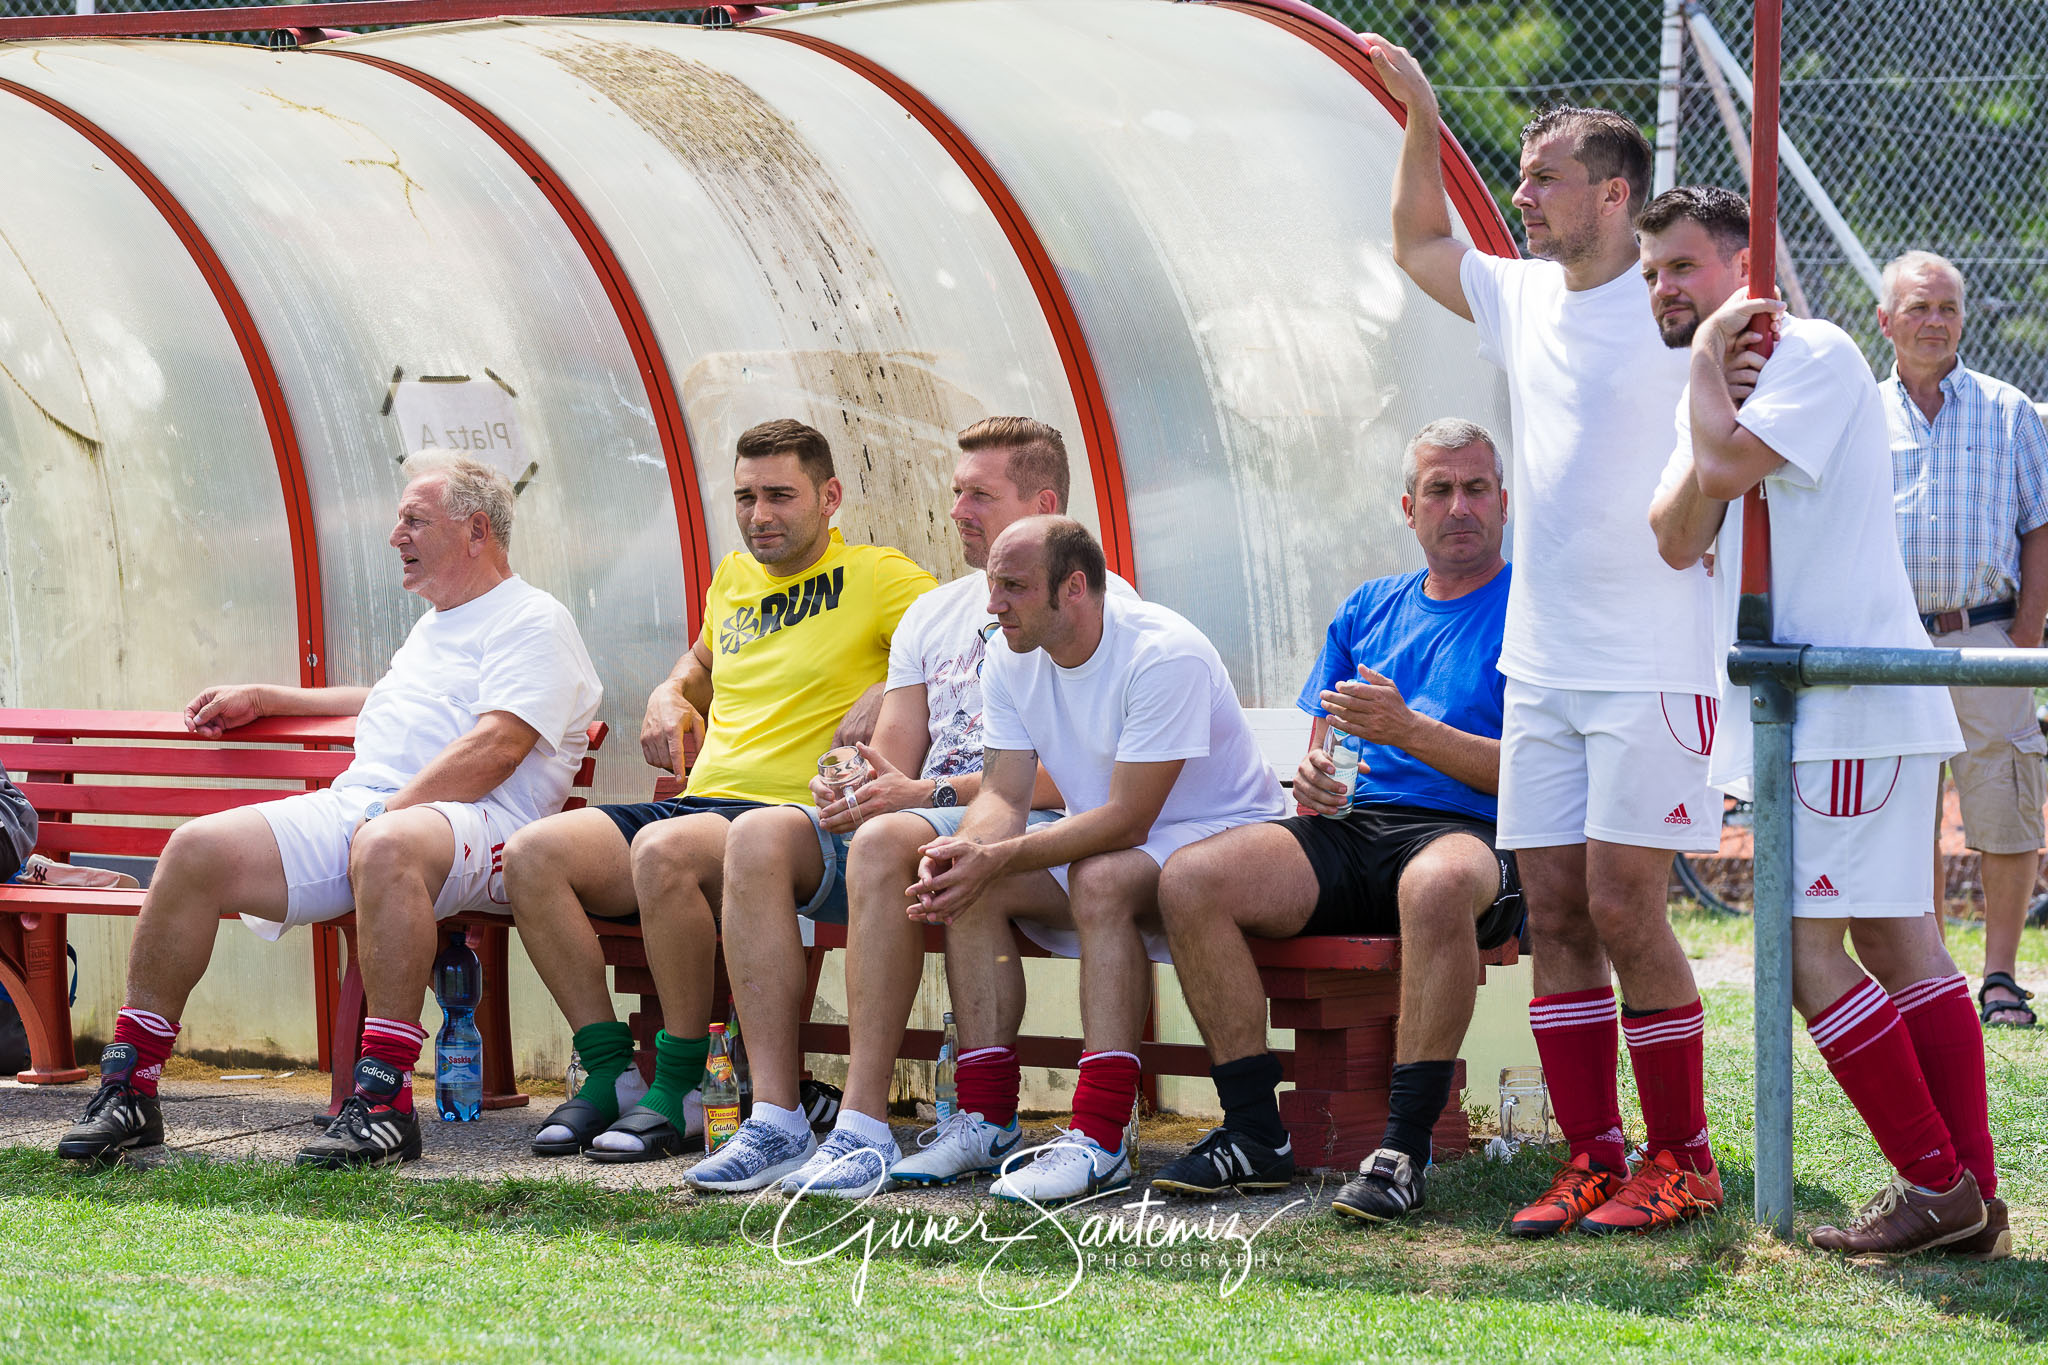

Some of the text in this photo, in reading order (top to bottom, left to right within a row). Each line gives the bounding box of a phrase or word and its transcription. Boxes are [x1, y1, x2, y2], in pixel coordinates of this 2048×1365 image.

[755, 566, 844, 640] RUN
[1664, 816, 1691, 825] adidas
[1805, 888, 1840, 897] adidas
[448, 1055, 472, 1064] Saskia
[136, 1069, 160, 1080] adida
[362, 1065, 396, 1085] adidas
[712, 1123, 737, 1133] ColaMix
[1595, 1135, 1625, 1145] adida
[1684, 1134, 1708, 1147] adida
